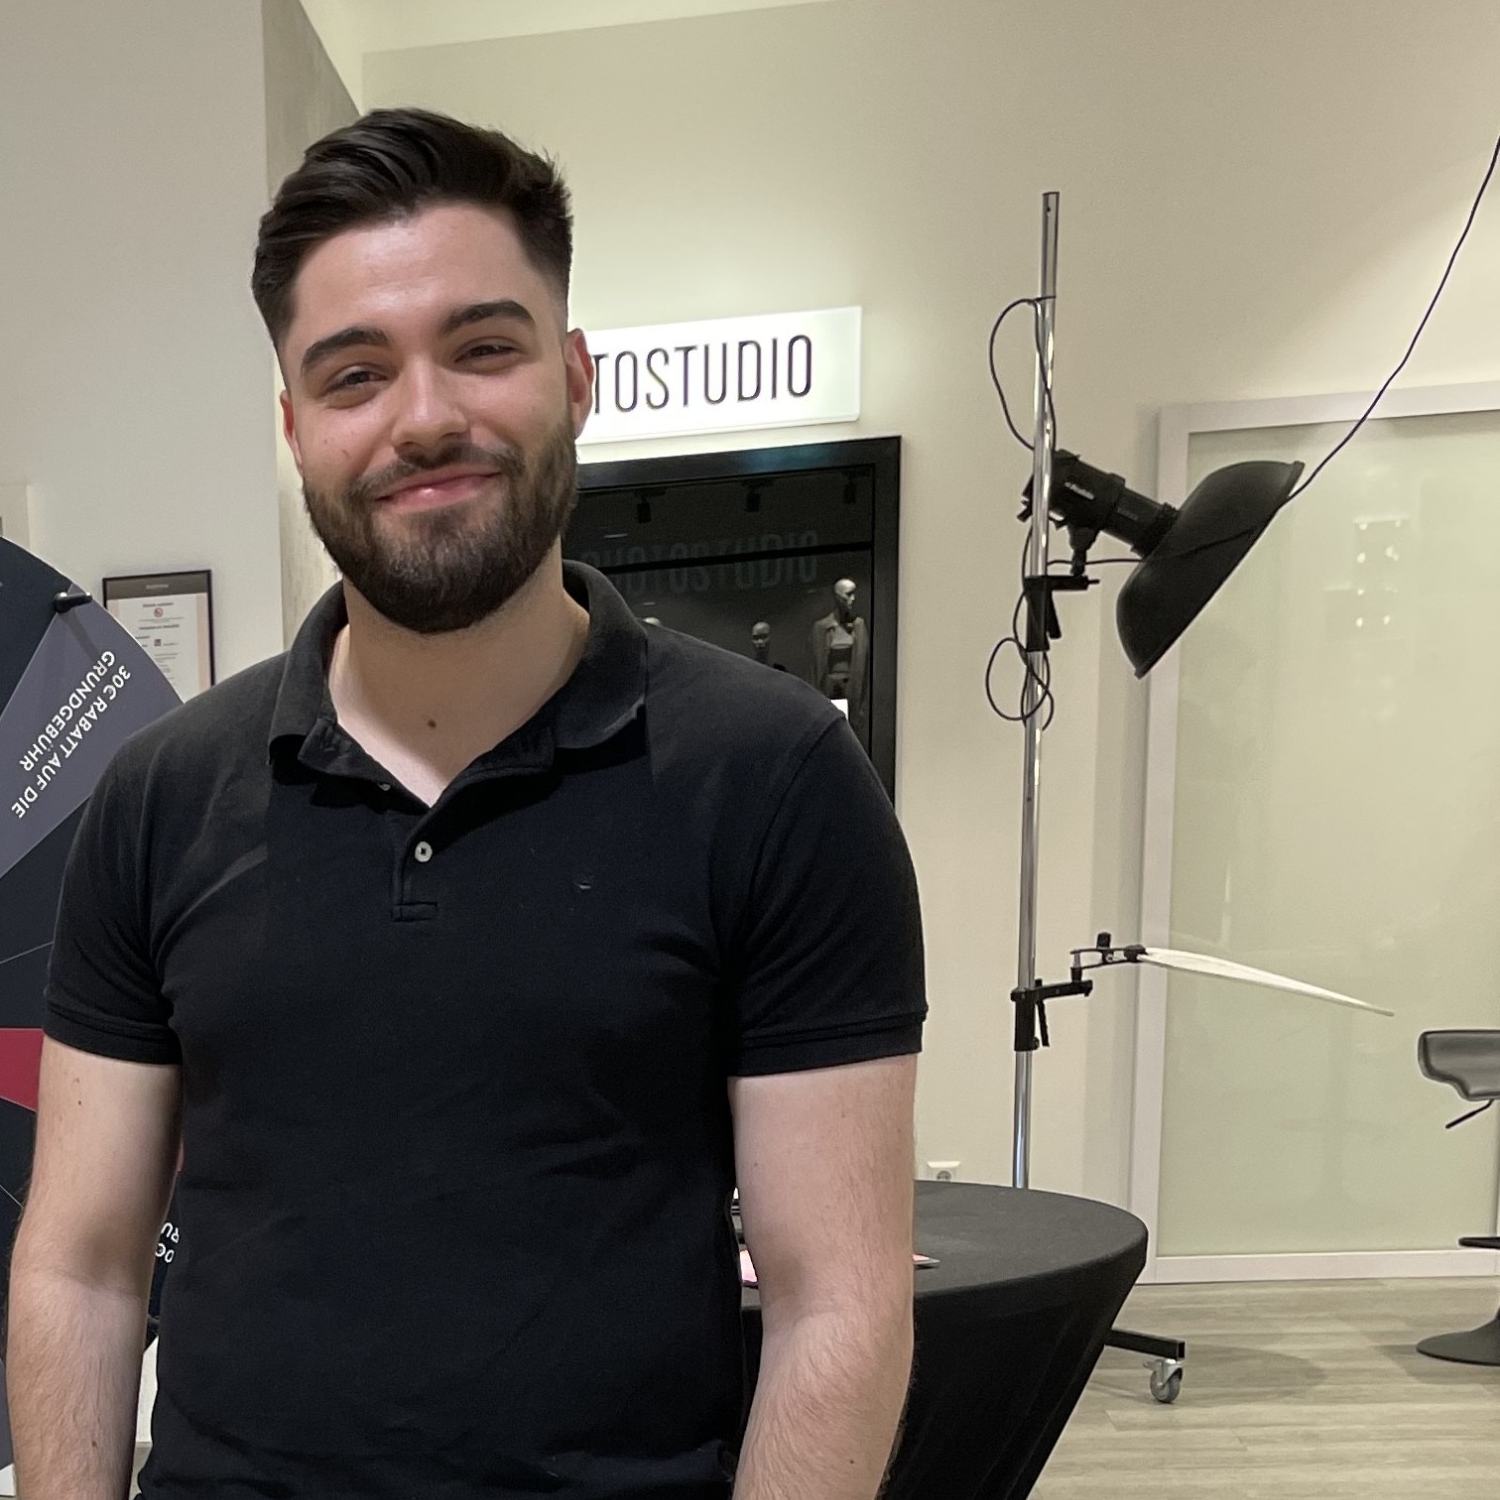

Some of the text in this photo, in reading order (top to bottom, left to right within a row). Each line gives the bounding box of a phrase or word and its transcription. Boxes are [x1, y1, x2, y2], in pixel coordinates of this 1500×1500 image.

[11, 665, 131, 818] 30€ RABATT AUF DIE
[19, 651, 115, 771] GRUNDGEBÜHR
